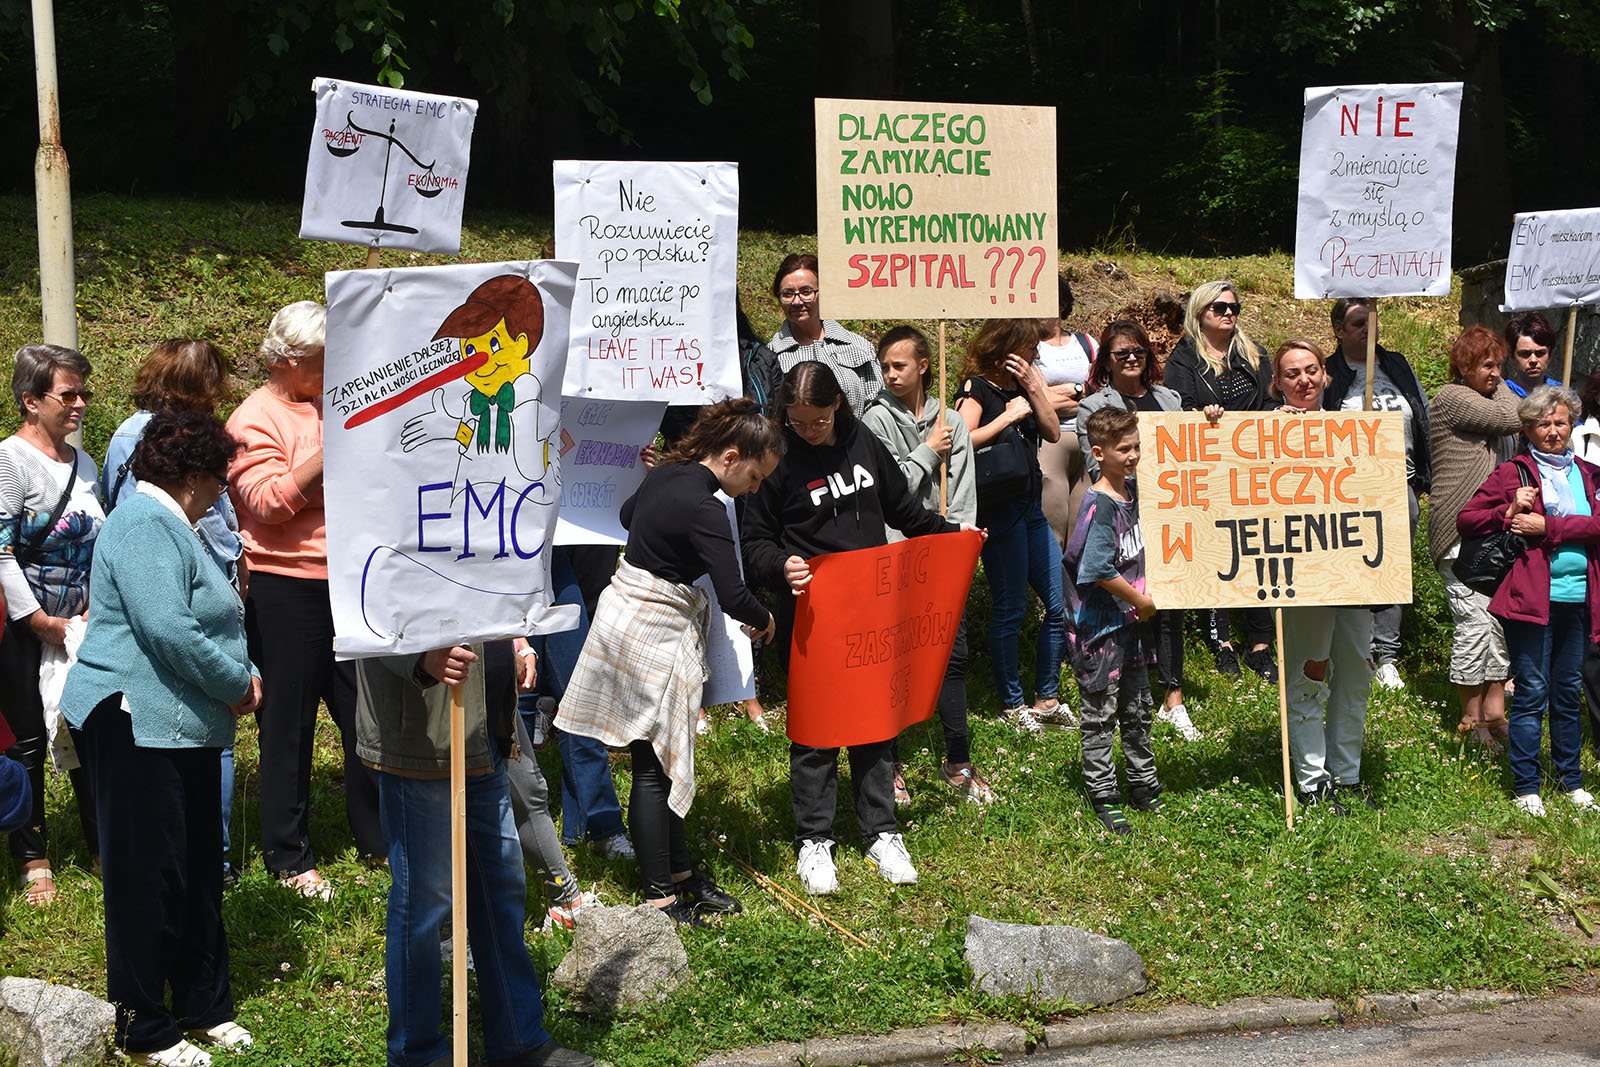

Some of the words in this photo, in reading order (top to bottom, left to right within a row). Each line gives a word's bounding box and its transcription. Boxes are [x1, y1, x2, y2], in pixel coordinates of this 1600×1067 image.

[351, 91, 411, 112] STRATEGIA
[416, 99, 448, 119] EMC
[838, 112, 986, 145] DLACZEGO
[840, 148, 991, 176] ZAMYKACIE
[407, 173, 459, 190] EKONOMIA
[618, 179, 656, 212] Nie
[842, 182, 913, 211] NOWO
[1362, 183, 1385, 204] się
[579, 215, 714, 240] Rozumiecie
[843, 212, 1047, 245] WYREMONTOWANY
[1411, 211, 1425, 226] o
[1515, 222, 1547, 247] EMC
[598, 247, 628, 273] po
[632, 240, 709, 273] polsku?
[847, 253, 976, 289] SZPITAL
[984, 246, 1047, 304] ???
[1510, 264, 1539, 292] EMC
[580, 277, 609, 304] To
[616, 281, 673, 304] macie
[678, 284, 700, 313] po
[418, 350, 461, 376] LECZNICZEJ
[588, 337, 638, 361] LEAVE
[650, 338, 673, 361] IT
[675, 338, 702, 361] AS
[326, 355, 413, 407] ZAPEWNIENIE
[411, 338, 453, 364] DALSZEJ
[621, 366, 645, 390] IT
[648, 362, 704, 389] WAS!
[574, 439, 640, 470] EKONOMIA
[1156, 422, 1221, 464] NIE
[1231, 418, 1382, 460] CHCEMY
[806, 463, 875, 507] FILA
[1157, 468, 1210, 512] SIĘ
[1229, 456, 1360, 506] LECZYĆ
[418, 476, 546, 563] EMC
[1161, 522, 1193, 565] W
[1215, 510, 1383, 582] JELENIEJ
[875, 547, 930, 597] EMC
[1255, 556, 1296, 601] !!!
[845, 602, 953, 669] ZASTANÓW
